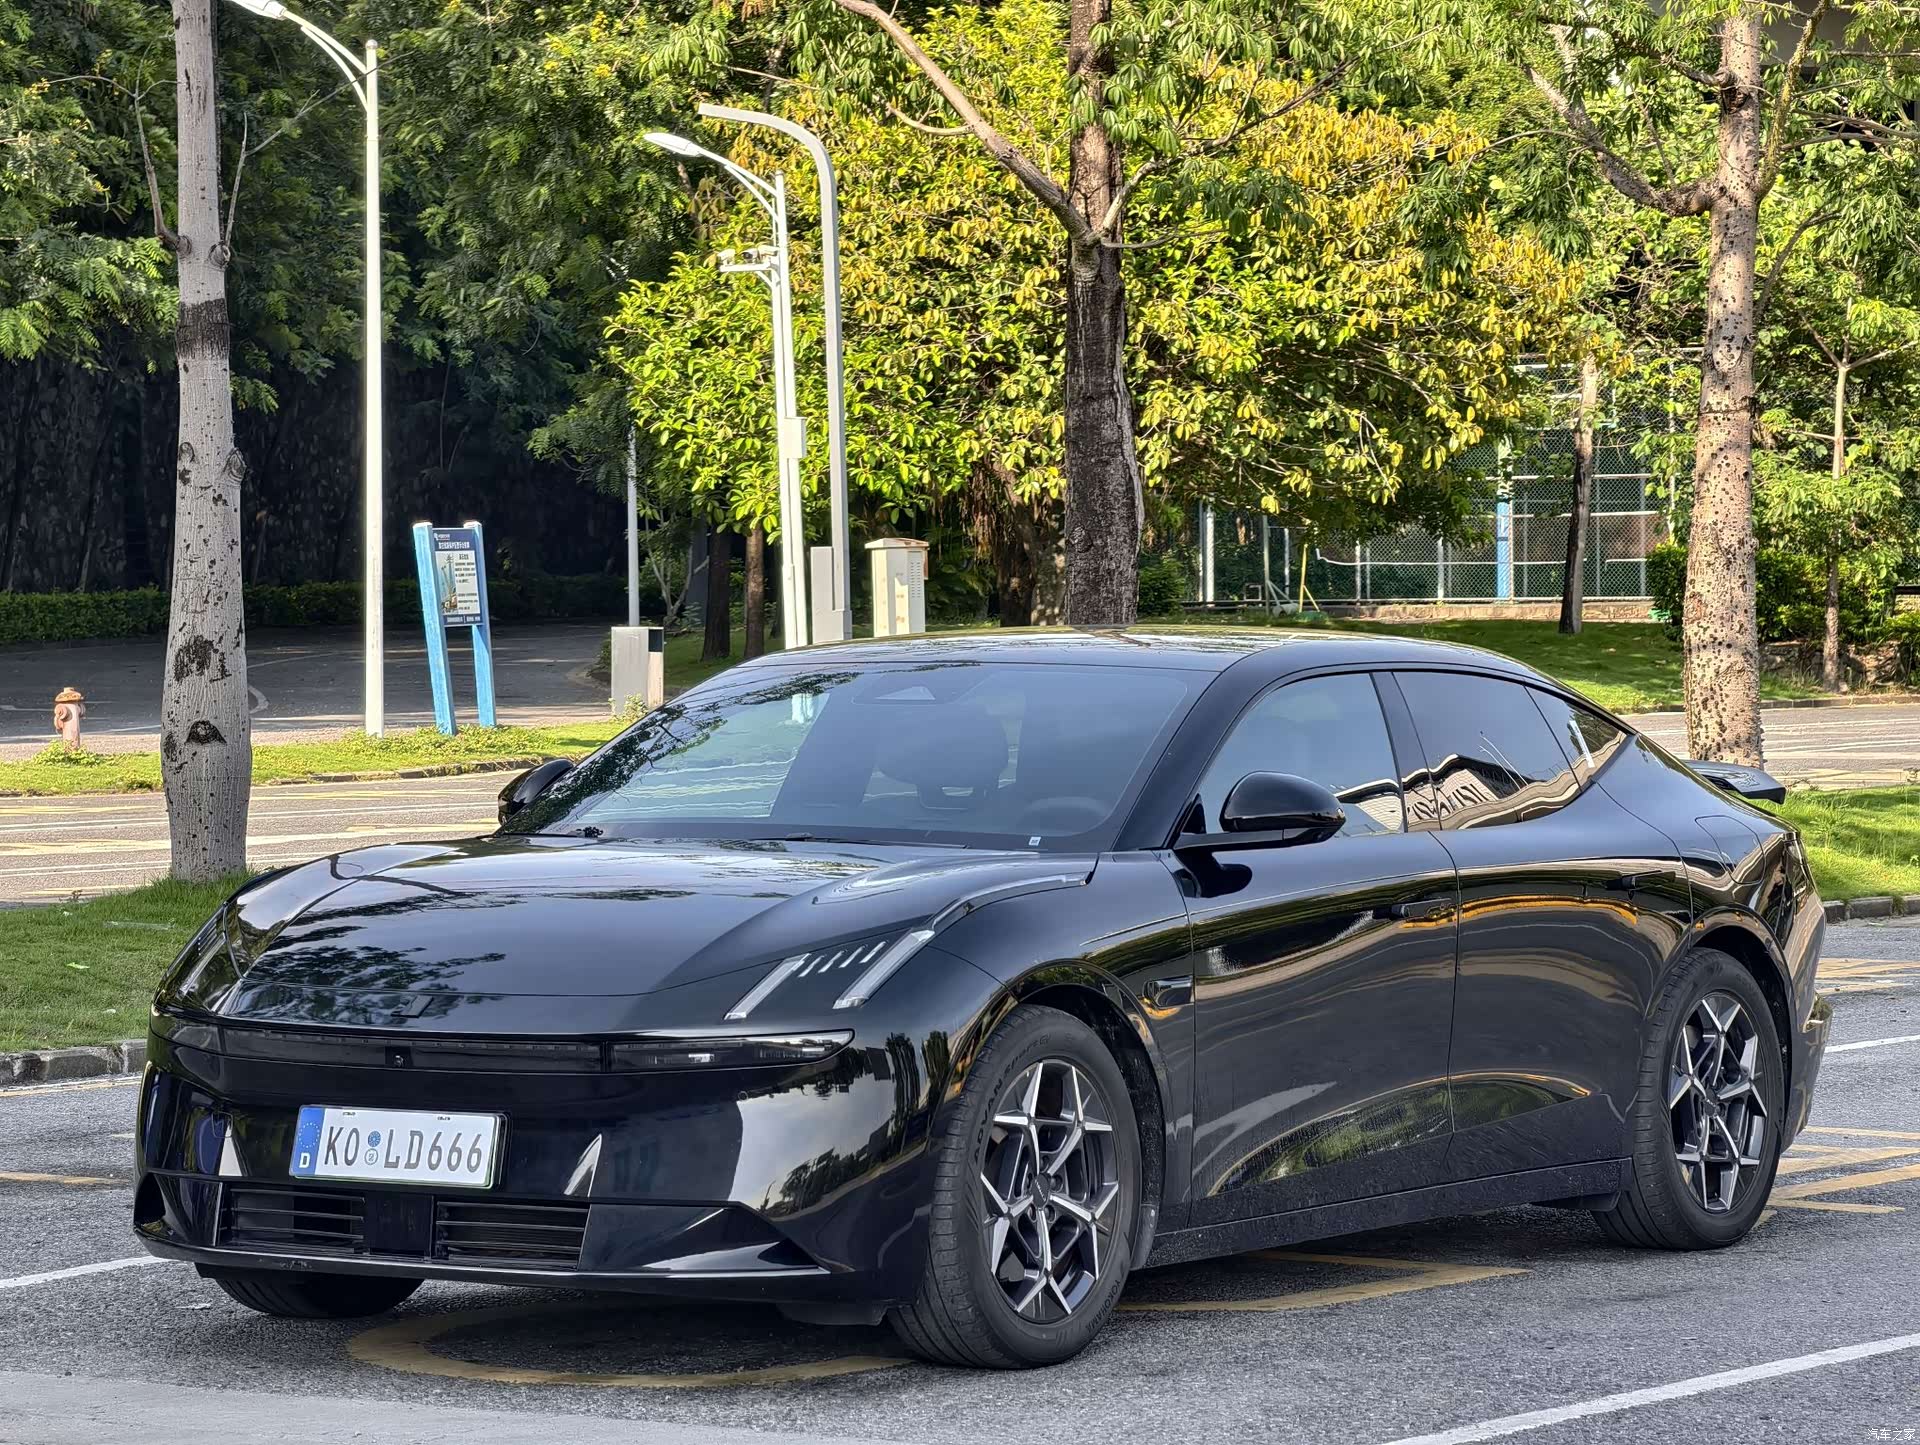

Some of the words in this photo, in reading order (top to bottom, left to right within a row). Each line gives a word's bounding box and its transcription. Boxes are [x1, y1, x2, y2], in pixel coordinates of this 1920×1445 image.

[298, 1152, 311, 1169] D
[324, 1126, 360, 1167] KO
[383, 1129, 483, 1174] LD666
[974, 1078, 1003, 1164] ADVAN
